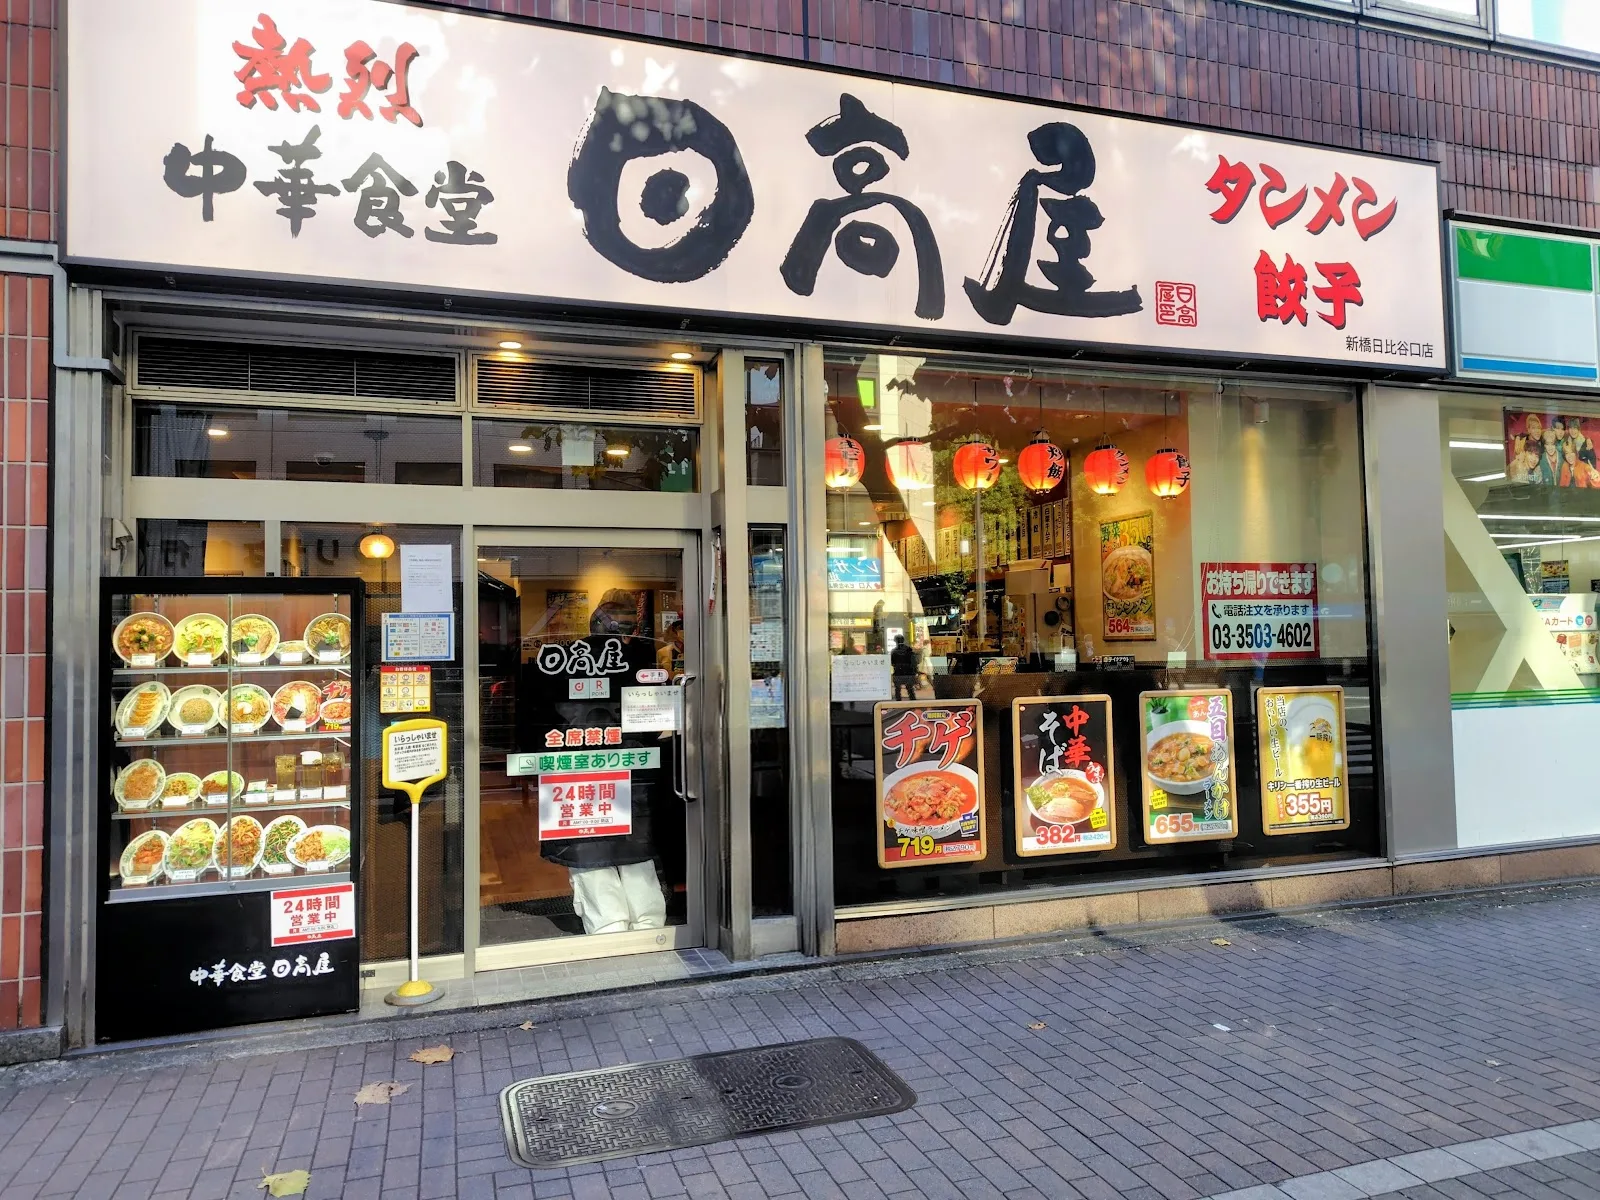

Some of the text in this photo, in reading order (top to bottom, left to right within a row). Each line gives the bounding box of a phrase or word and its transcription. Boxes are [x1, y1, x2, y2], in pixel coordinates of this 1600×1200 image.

[232, 13, 424, 127] 熱烈
[163, 124, 498, 246] 中華食堂
[1205, 153, 1398, 242] タンメン
[567, 86, 1144, 325] 日高屋
[1255, 249, 1363, 329] 餃子
[1345, 336, 1434, 359] 新橋日比谷口店
[1206, 569, 1314, 595] お持ち帰りできます
[1223, 604, 1310, 616] 電話注文を承ります
[1212, 622, 1311, 649] 03-3503-4602
[537, 638, 629, 676] 日高屋
[394, 731, 437, 743] いらっしゃいませ
[545, 727, 622, 747] 全席禁煙
[882, 711, 972, 770] チゲ
[1039, 711, 1067, 777] そば
[1063, 705, 1091, 768] 中華
[1265, 698, 1283, 777] おいしい生ビール
[539, 751, 651, 771] 喫煙室あります
[552, 783, 616, 802] 24時間
[1267, 777, 1341, 792] キリン一番搾り生ビール
[560, 802, 612, 818] 営業中
[1203, 781, 1213, 820] ラーメン
[1285, 793, 1333, 816] 355円
[283, 895, 340, 914] 24時間
[291, 911, 336, 926] 営業中
[190, 952, 335, 987] 中華食堂 日高屋
